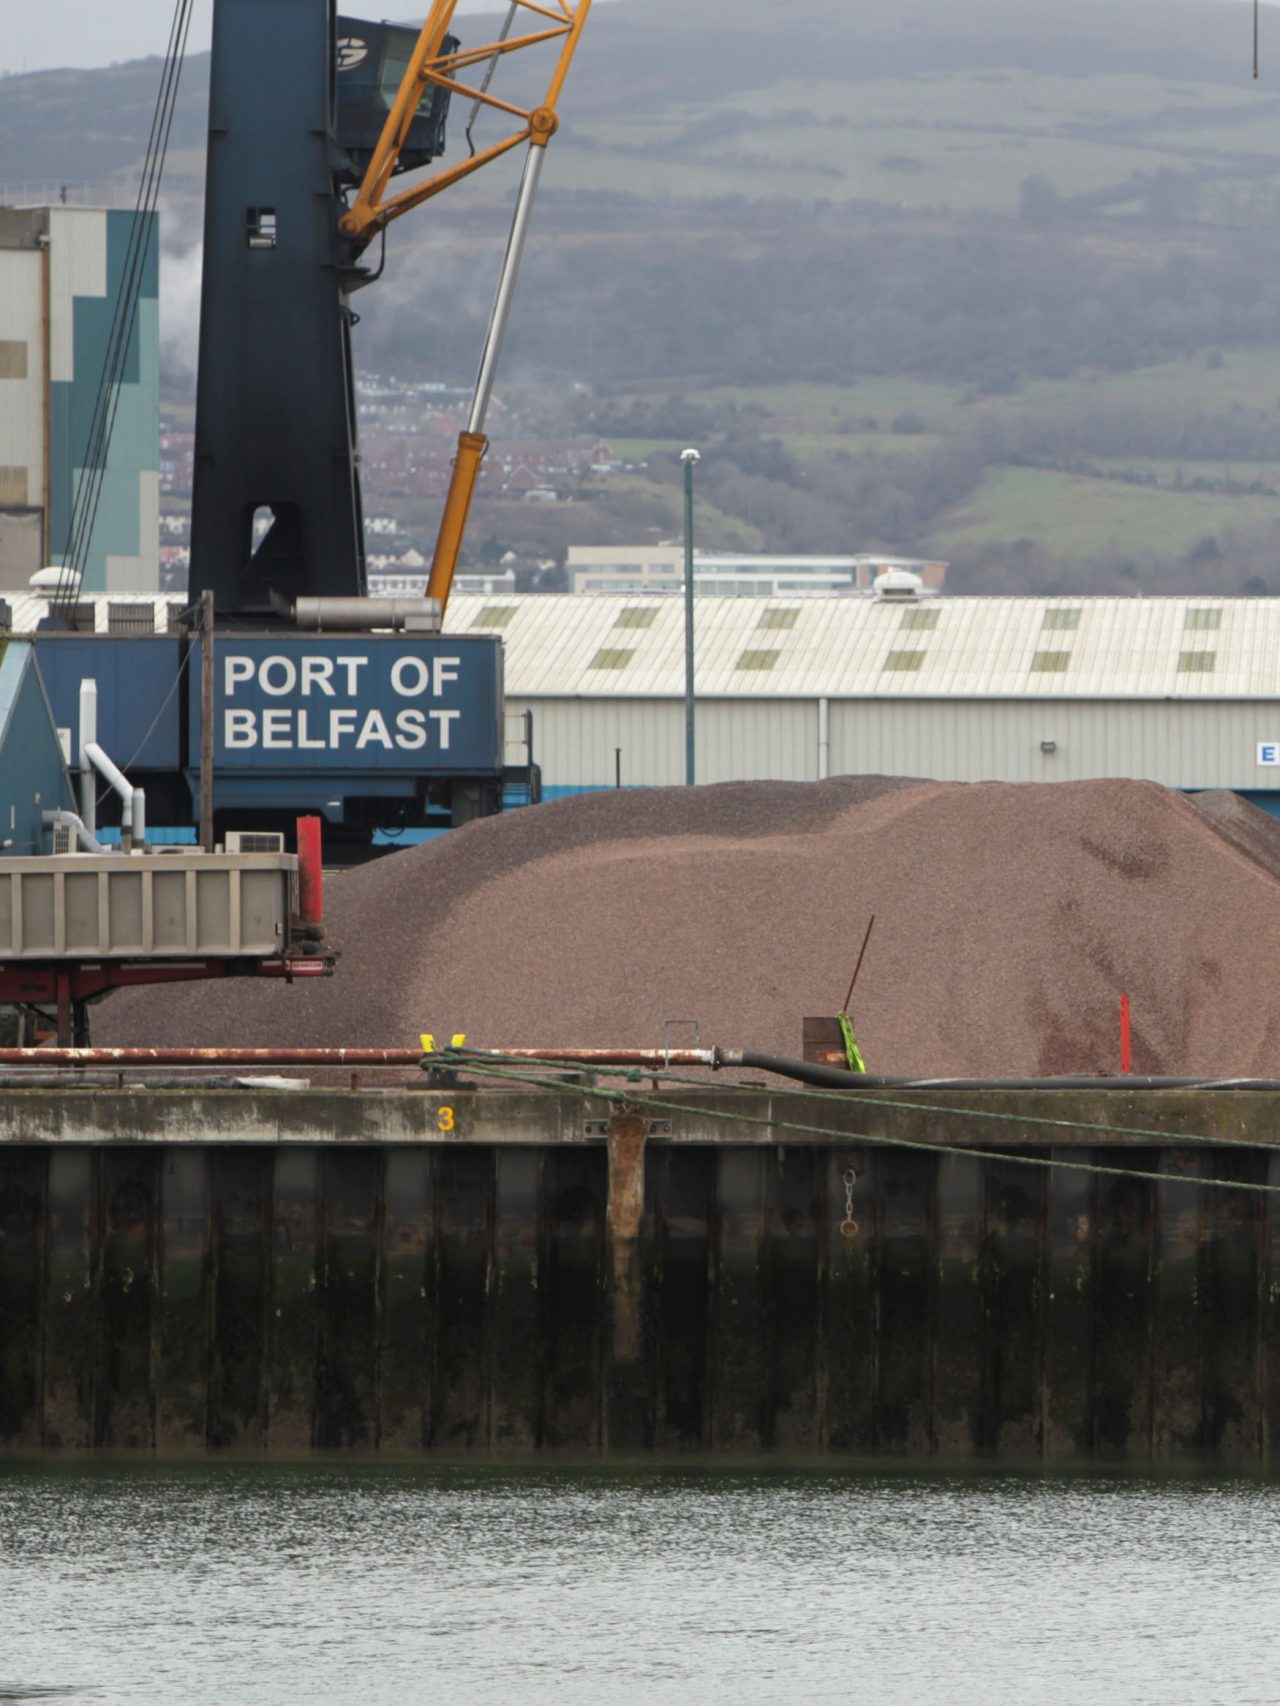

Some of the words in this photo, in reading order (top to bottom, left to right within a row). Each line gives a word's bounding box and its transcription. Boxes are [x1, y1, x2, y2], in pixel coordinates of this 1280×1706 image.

[225, 656, 368, 696] PORT
[390, 656, 461, 697] OF
[225, 709, 461, 750] BELFAST
[1262, 746, 1275, 762] E
[437, 1106, 455, 1131] 3
